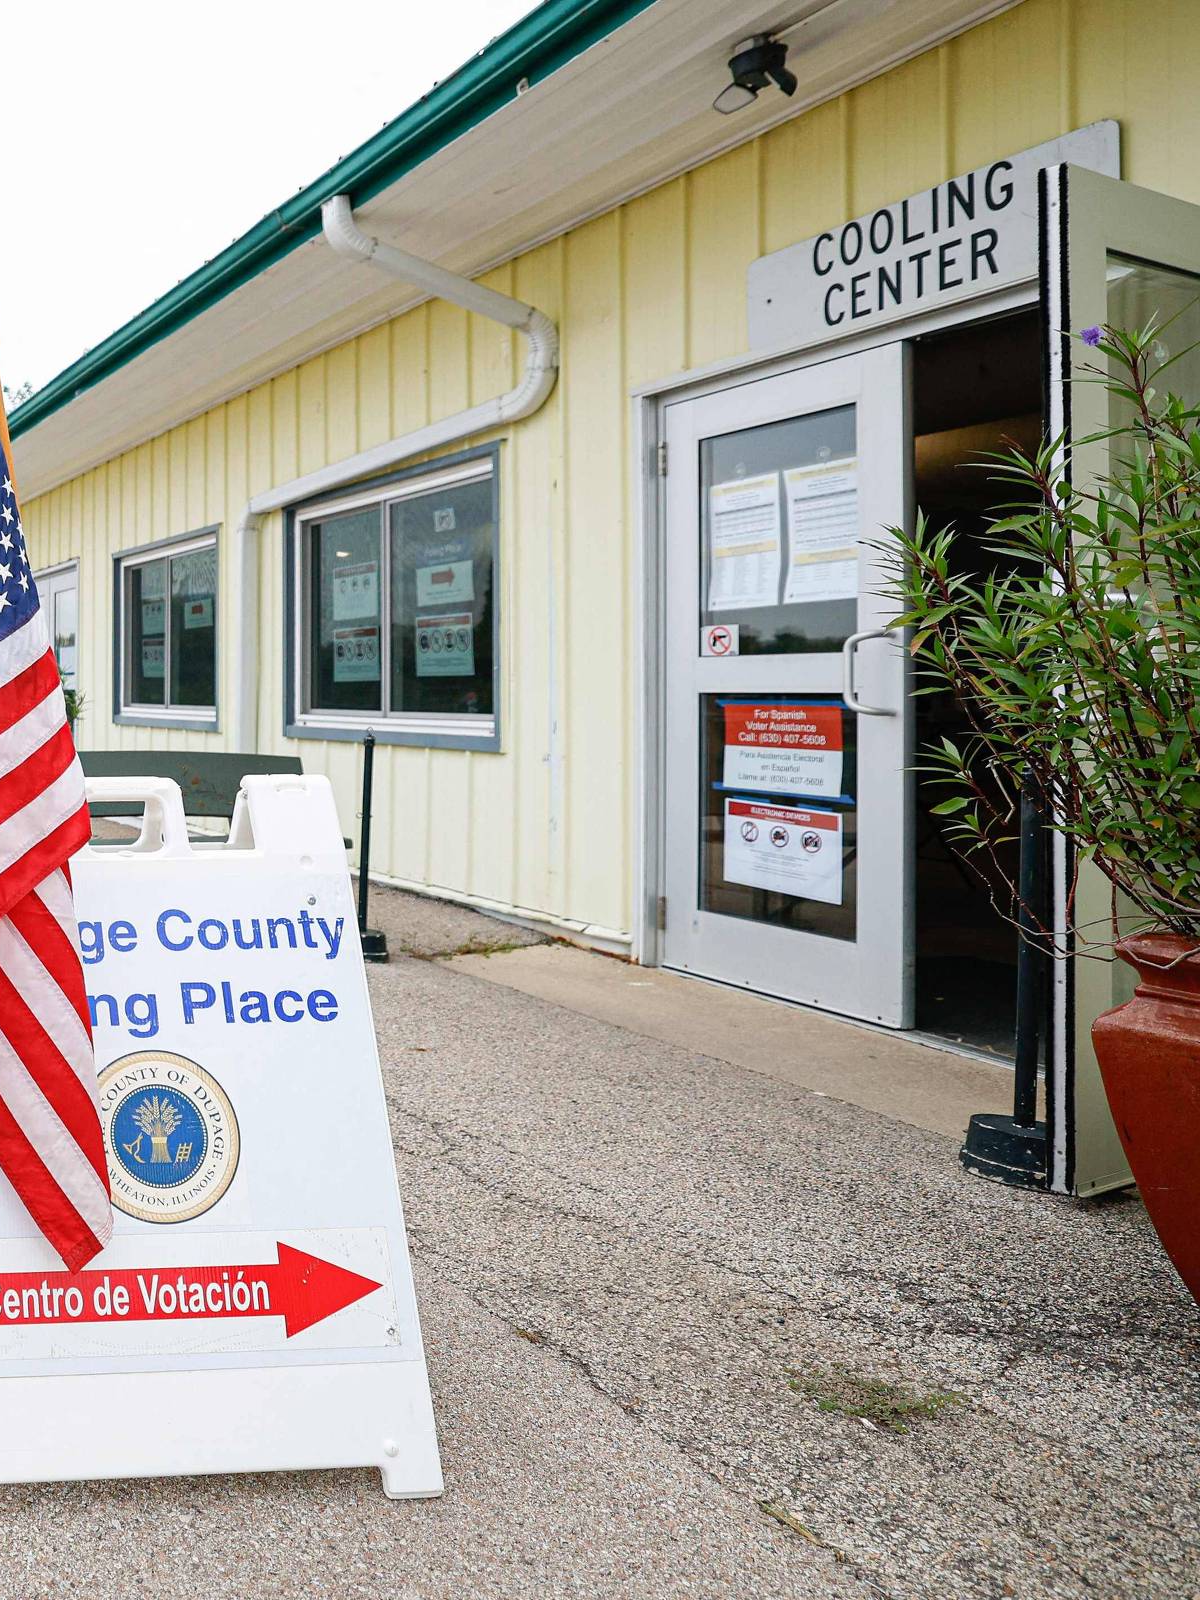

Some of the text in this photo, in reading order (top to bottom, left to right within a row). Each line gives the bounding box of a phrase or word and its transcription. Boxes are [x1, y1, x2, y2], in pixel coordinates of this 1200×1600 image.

[813, 161, 1013, 276] COOLING
[824, 228, 999, 326] CENTER
[745, 721, 816, 733] Voter Assistance
[754, 709, 806, 721] For Spanish
[156, 909, 344, 959] County
[180, 981, 338, 1024] Place
[101, 1067, 224, 1160] COUNTY OF DUPAGE
[172, 1168, 215, 1205] ILLINOIS
[93, 1276, 130, 1315] de
[137, 1271, 270, 1314] Votación
